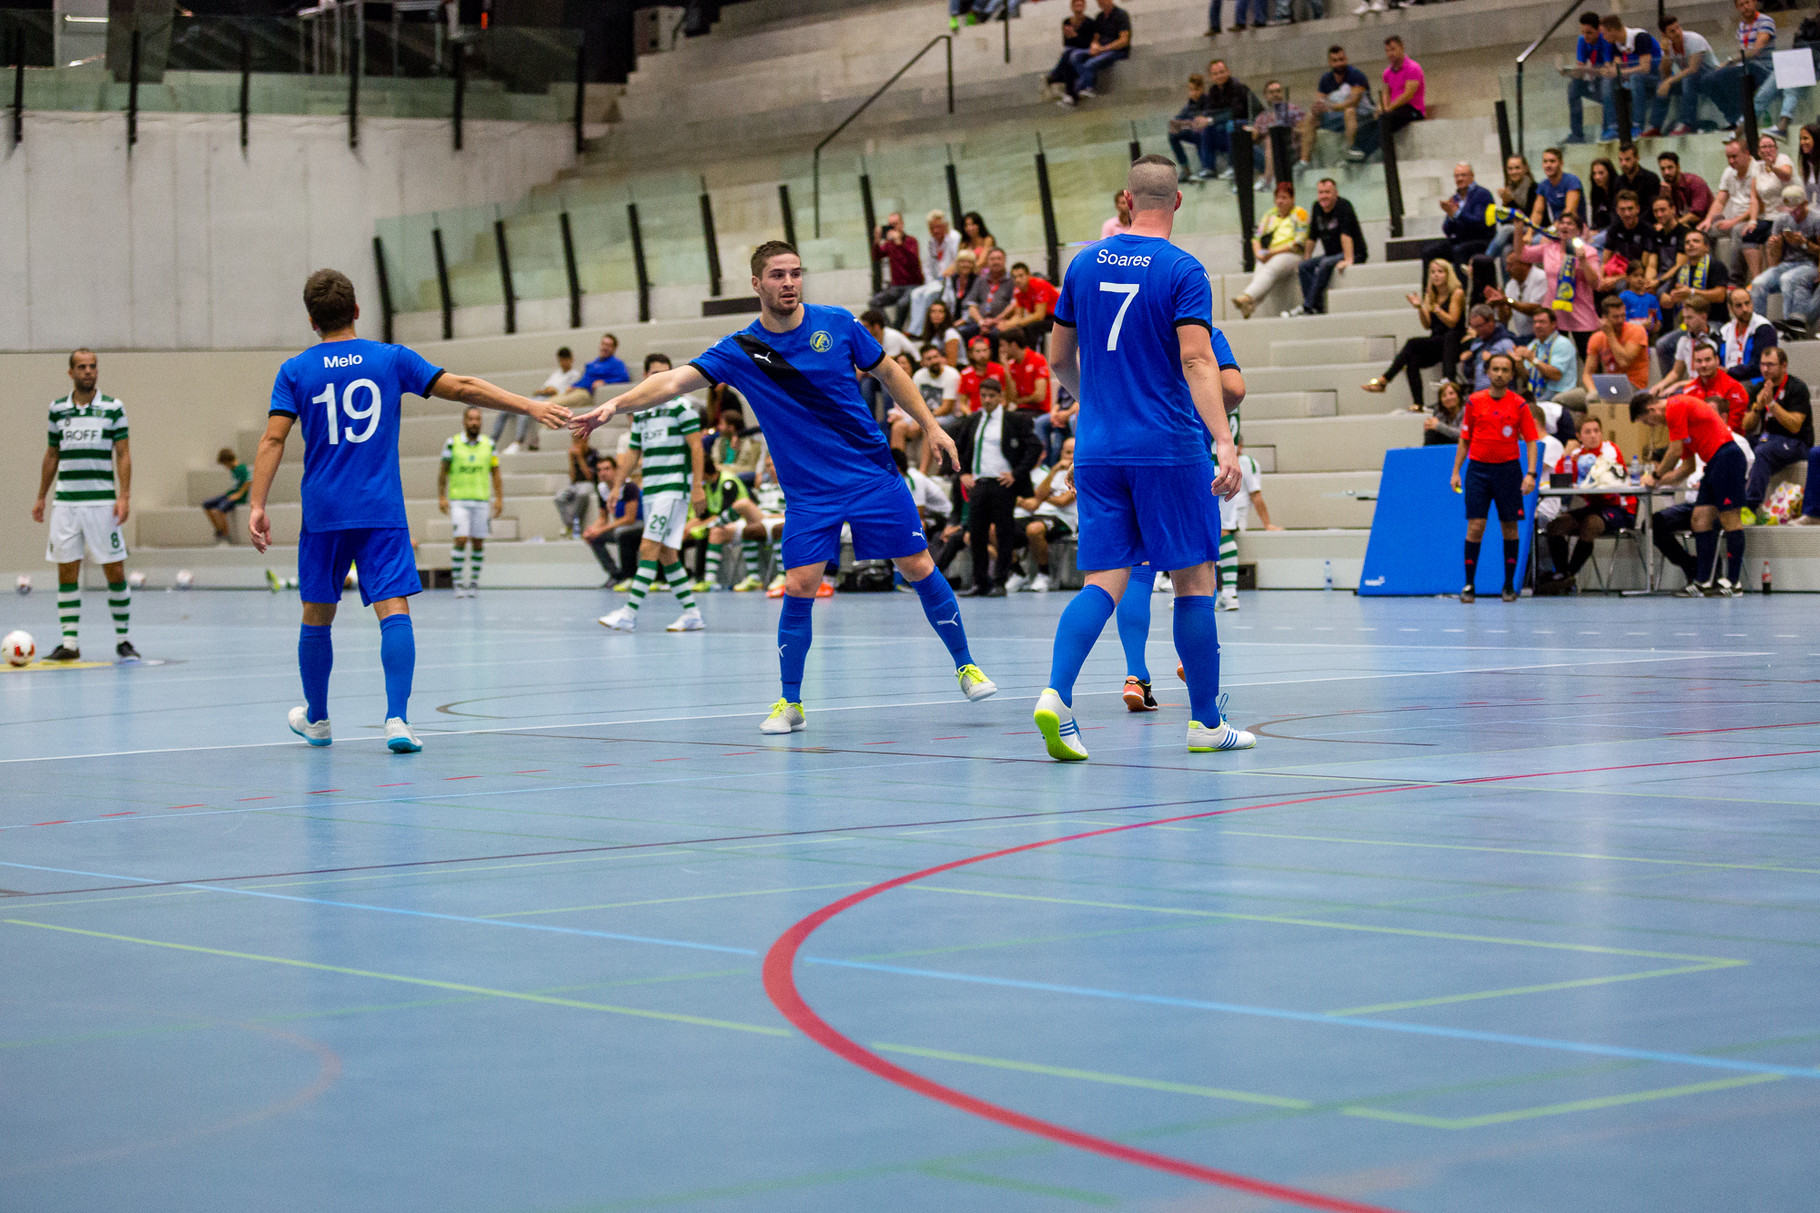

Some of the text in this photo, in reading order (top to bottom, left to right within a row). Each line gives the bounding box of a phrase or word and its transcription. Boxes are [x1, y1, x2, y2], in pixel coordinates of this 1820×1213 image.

[1096, 248, 1152, 268] Soares
[1099, 281, 1140, 352] 7
[323, 353, 363, 369] Melo
[311, 378, 382, 445] 19
[65, 429, 98, 441] ROFF
[649, 514, 667, 530] 29
[110, 532, 120, 549] 8
